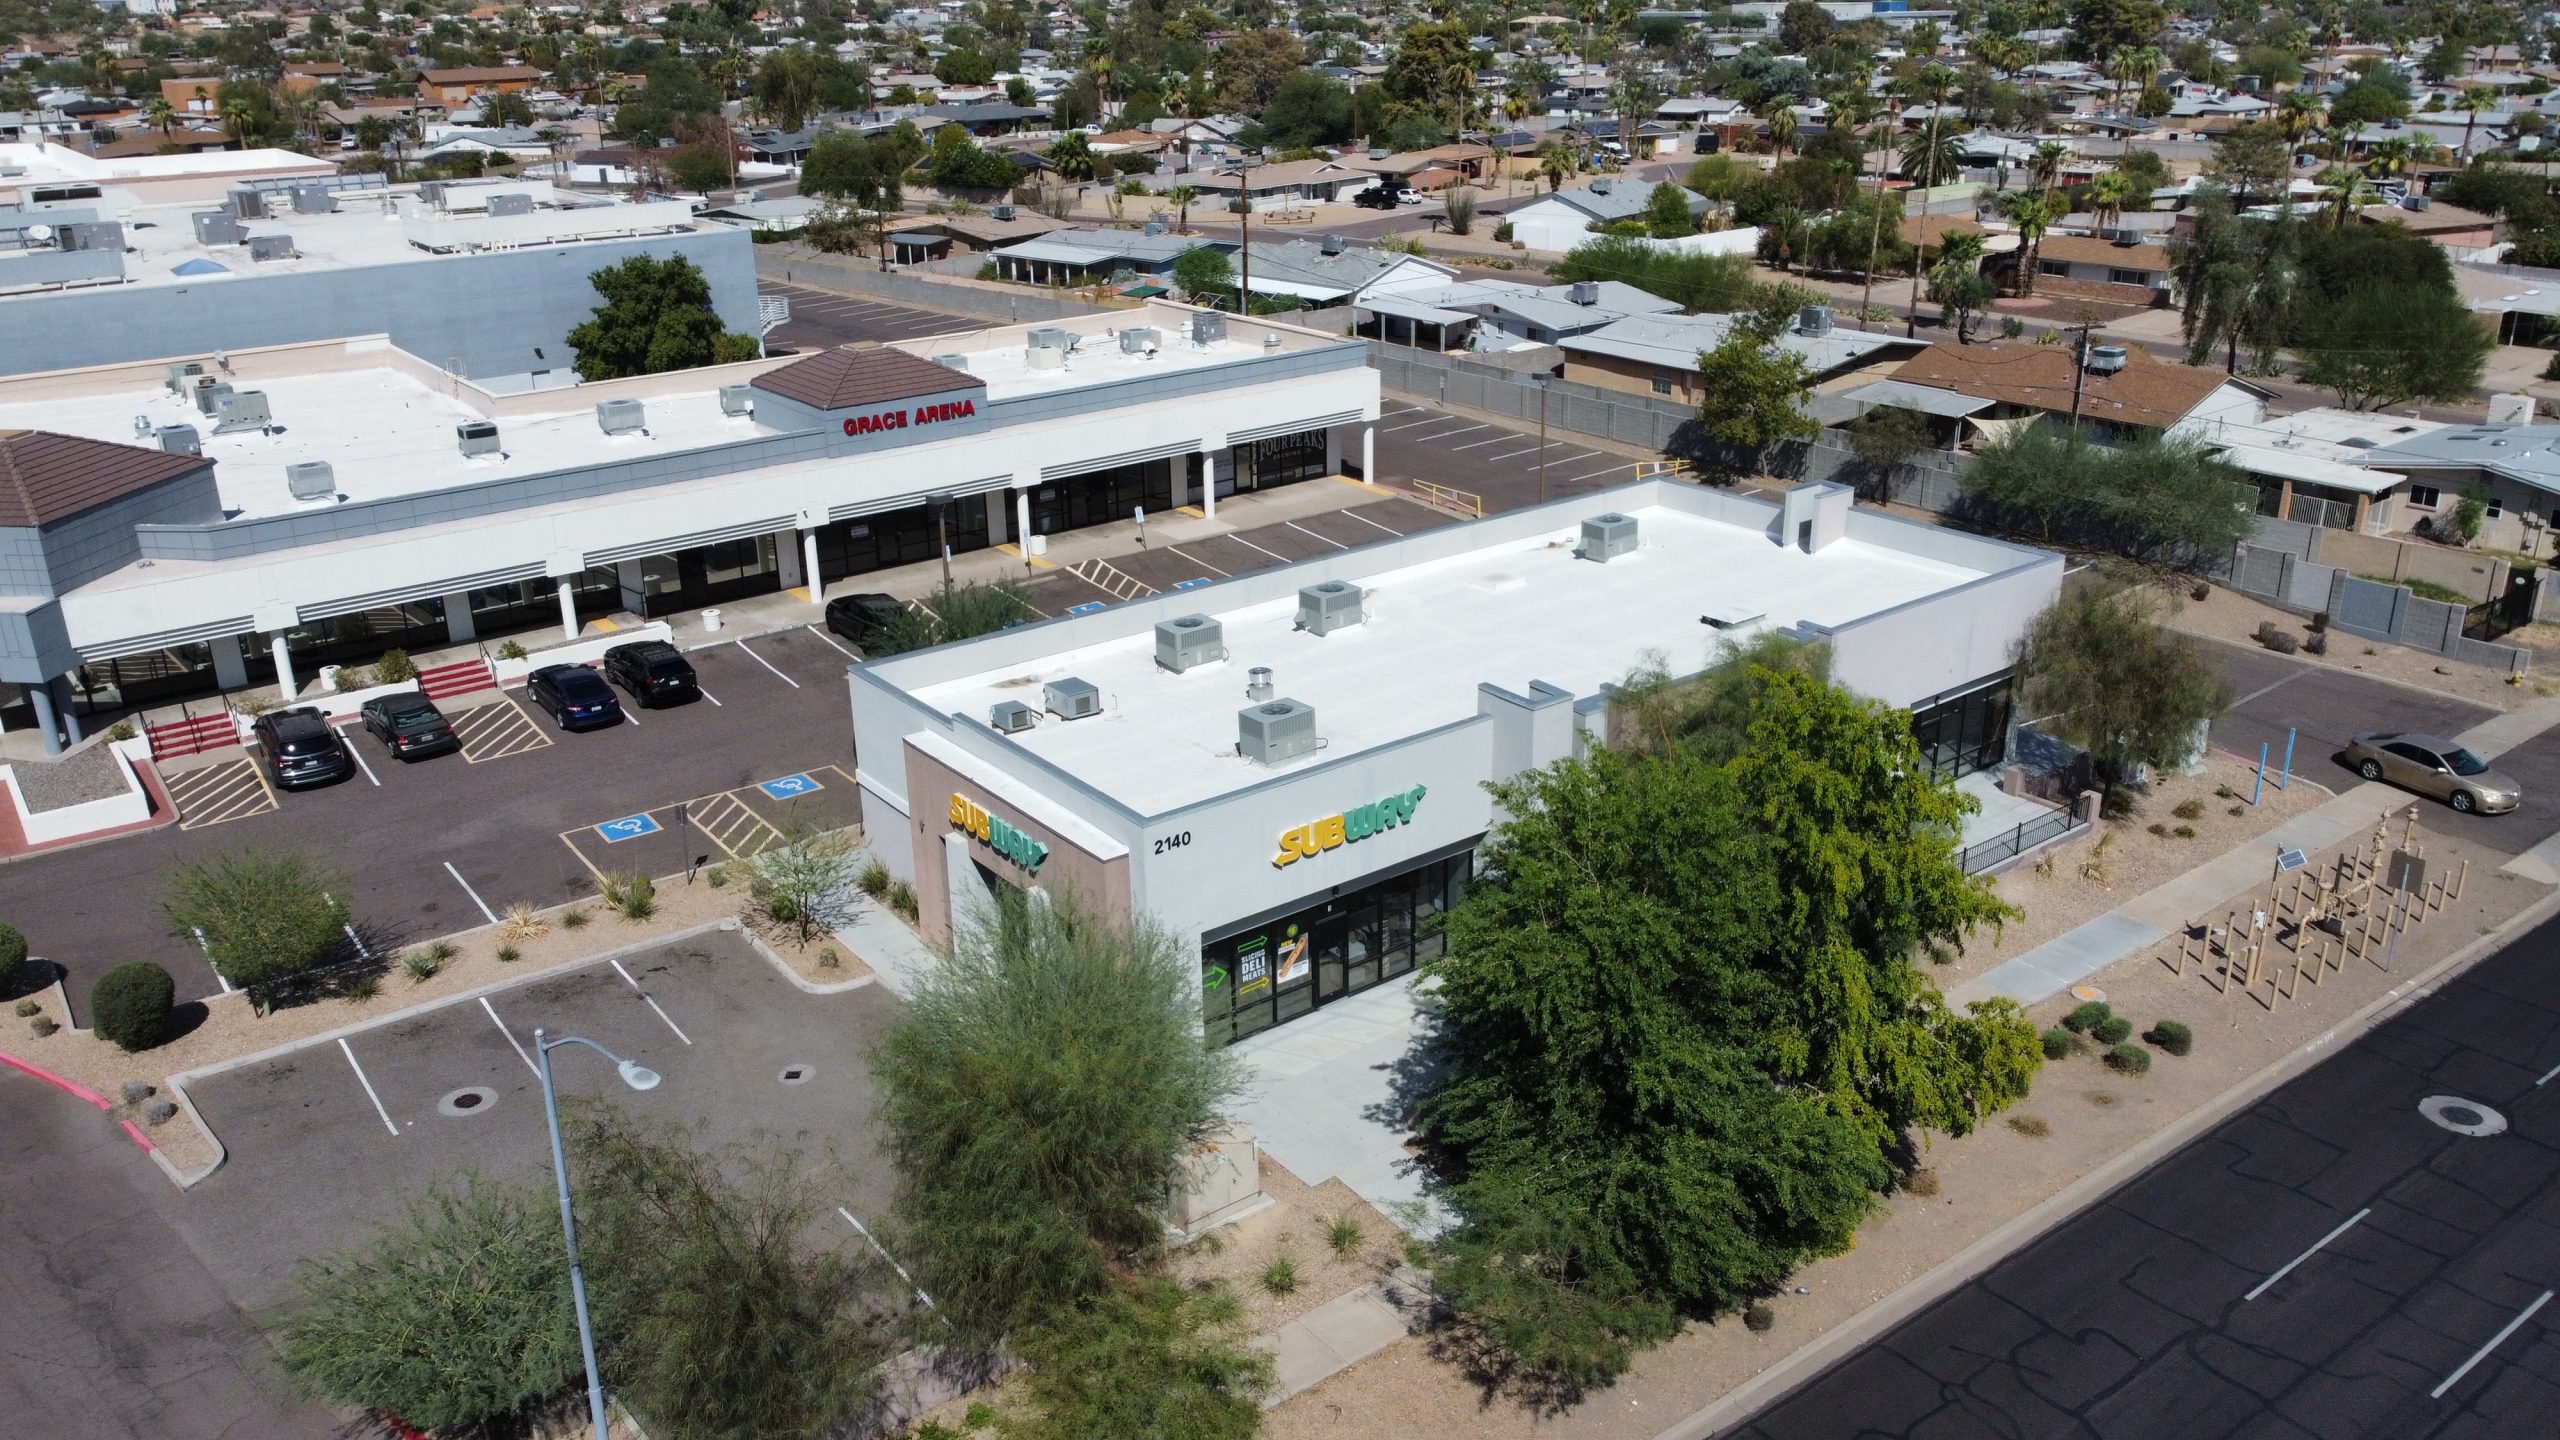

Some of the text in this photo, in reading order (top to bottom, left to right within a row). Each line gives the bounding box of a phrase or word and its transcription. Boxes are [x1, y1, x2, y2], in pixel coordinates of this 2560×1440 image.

[843, 399, 975, 436] GRACE ARENA
[1260, 428, 1324, 462] FOUR PEAKS
[948, 792, 1049, 872] SUBWAY
[1271, 783, 1427, 870] SUBWAY
[1155, 831, 1191, 855] 2140
[1241, 949, 1265, 963] SLICING
[1241, 956, 1265, 975] DELI
[1242, 967, 1265, 982] MEATS
